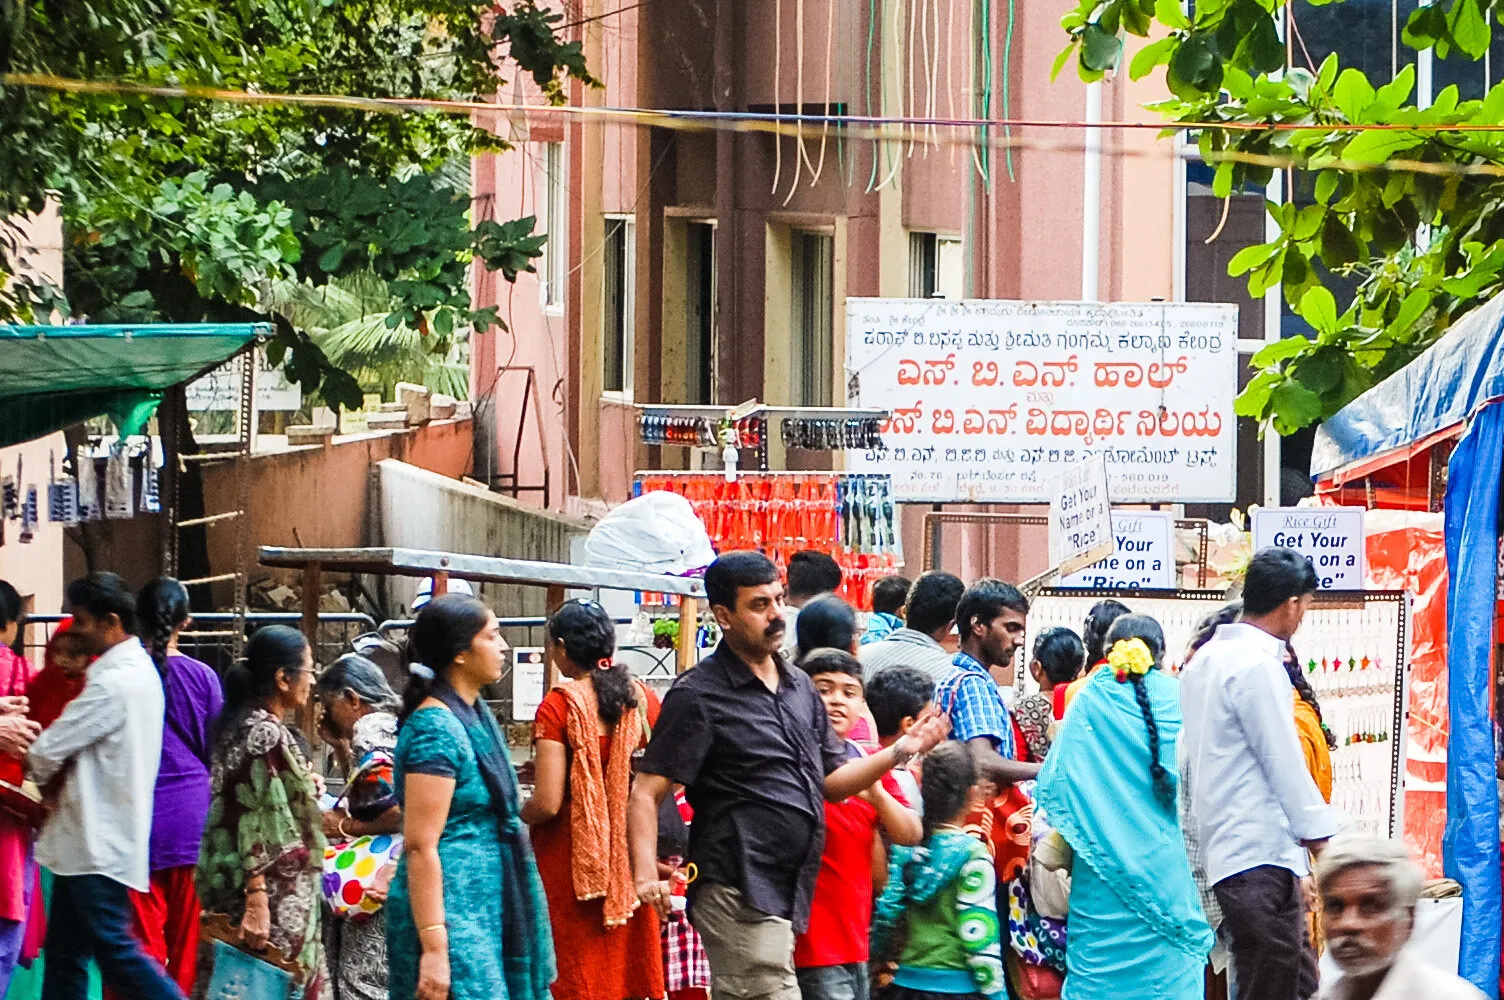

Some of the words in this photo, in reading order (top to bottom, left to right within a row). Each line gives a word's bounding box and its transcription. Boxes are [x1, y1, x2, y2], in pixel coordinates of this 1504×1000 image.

[968, 330, 999, 350] ಮತ್ತು
[1178, 330, 1222, 353] ಕೇಂದ್ರ
[1094, 355, 1188, 389] ಹಾಲ್
[1136, 403, 1222, 437] ನಿಲಯ
[1118, 518, 1143, 534] Gift
[1284, 514, 1310, 528] Rice
[1313, 512, 1338, 530] Gift
[1115, 535, 1154, 552] Your
[1273, 531, 1304, 548] Get
[1310, 531, 1349, 549] Your
[1125, 558, 1145, 571] on
[1152, 559, 1161, 571] a
[1319, 554, 1341, 567] on
[1345, 554, 1356, 567] a
